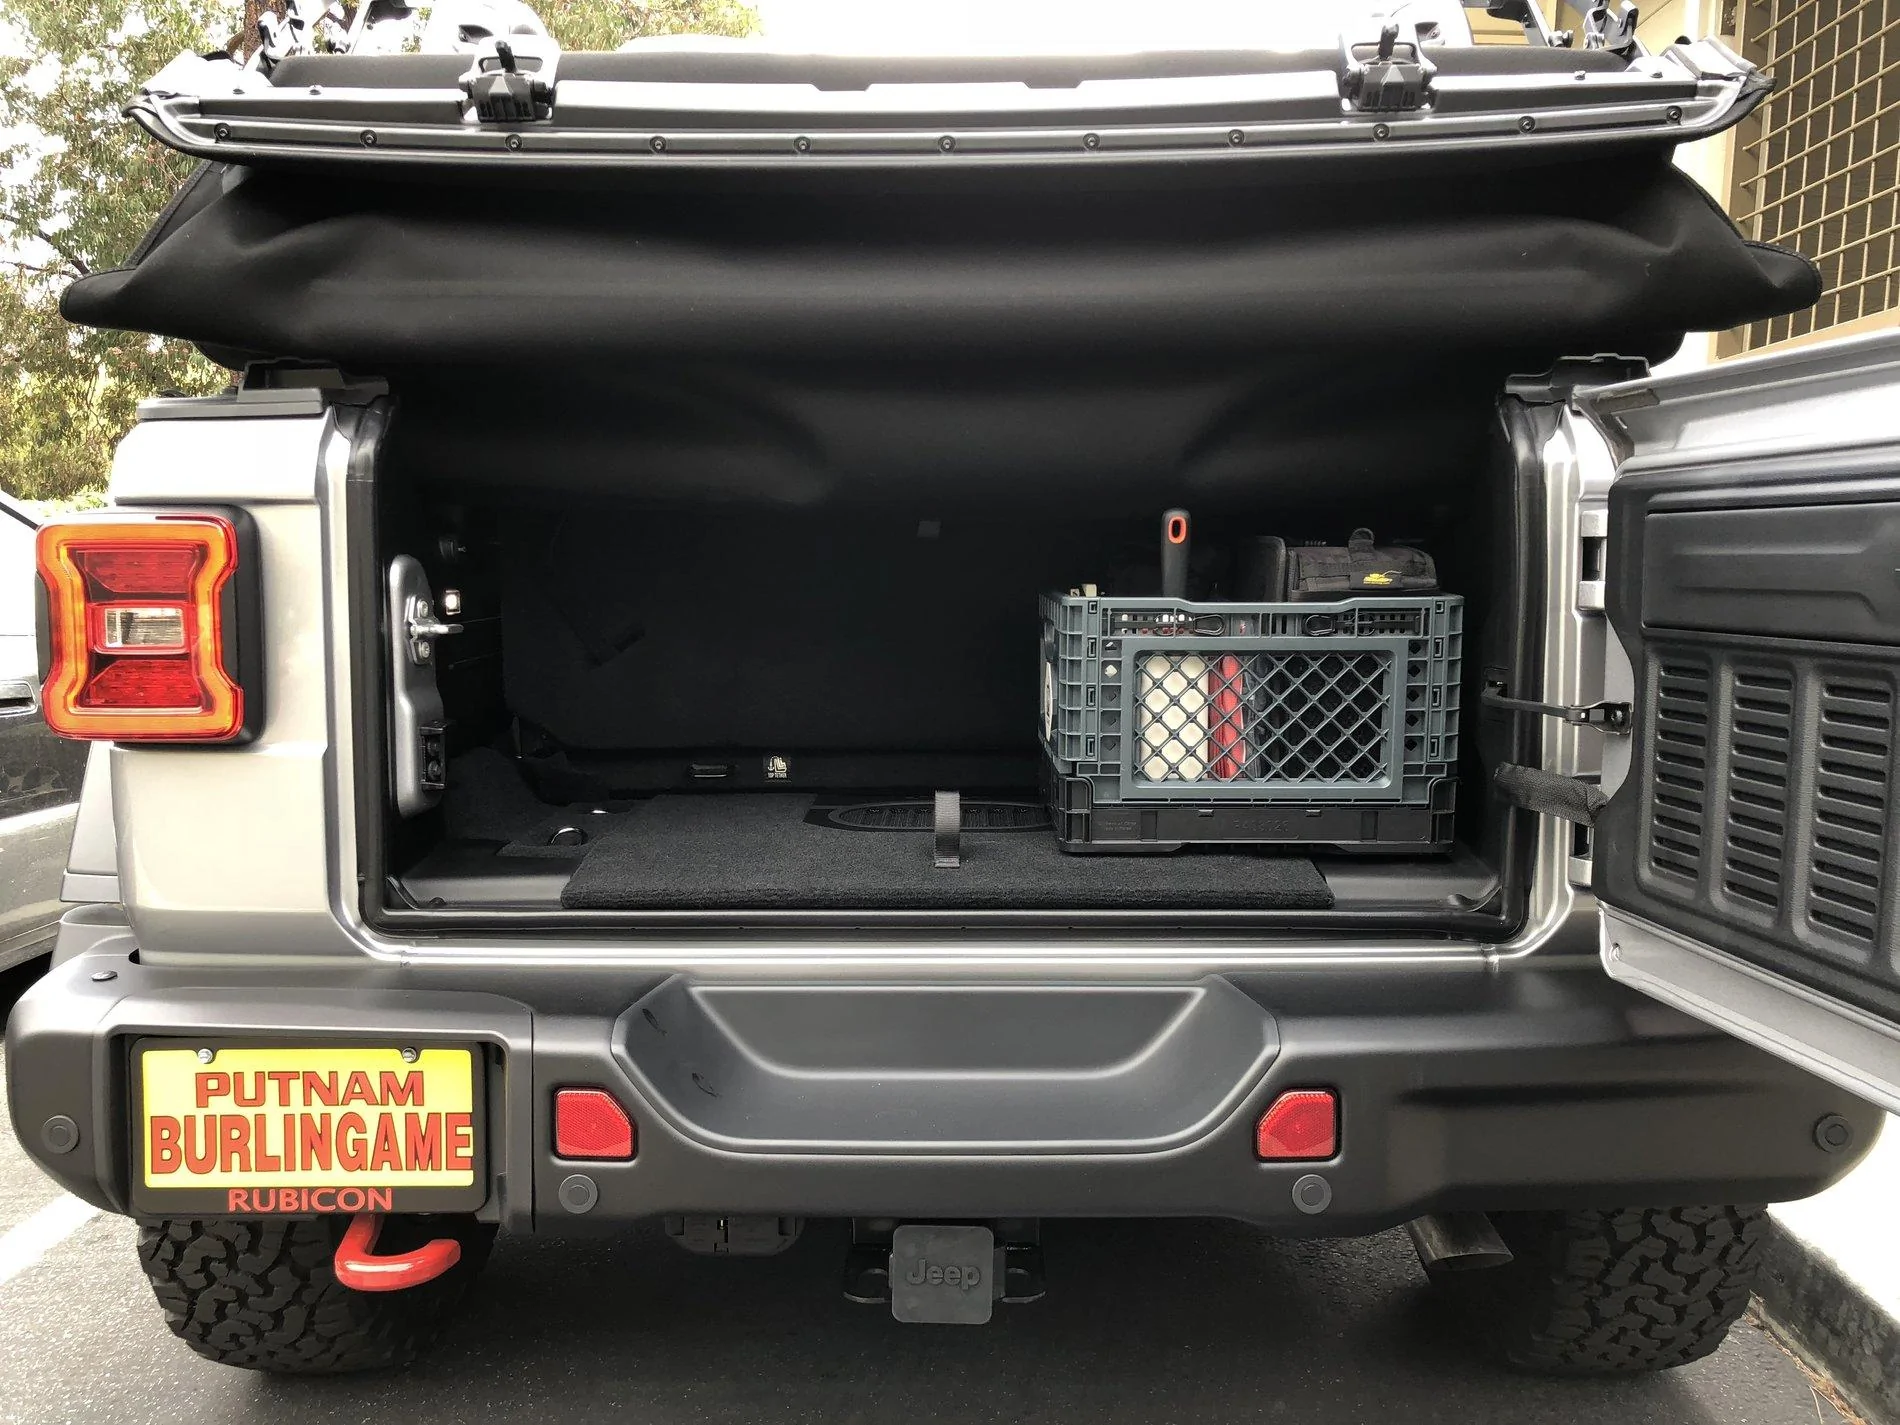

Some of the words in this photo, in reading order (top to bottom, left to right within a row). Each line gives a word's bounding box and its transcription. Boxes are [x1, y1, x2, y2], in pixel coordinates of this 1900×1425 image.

[195, 1071, 425, 1108] PUTNAM
[150, 1112, 473, 1174] BURLINGAME
[227, 1188, 393, 1212] RUBICON
[905, 1259, 981, 1290] Jeep
